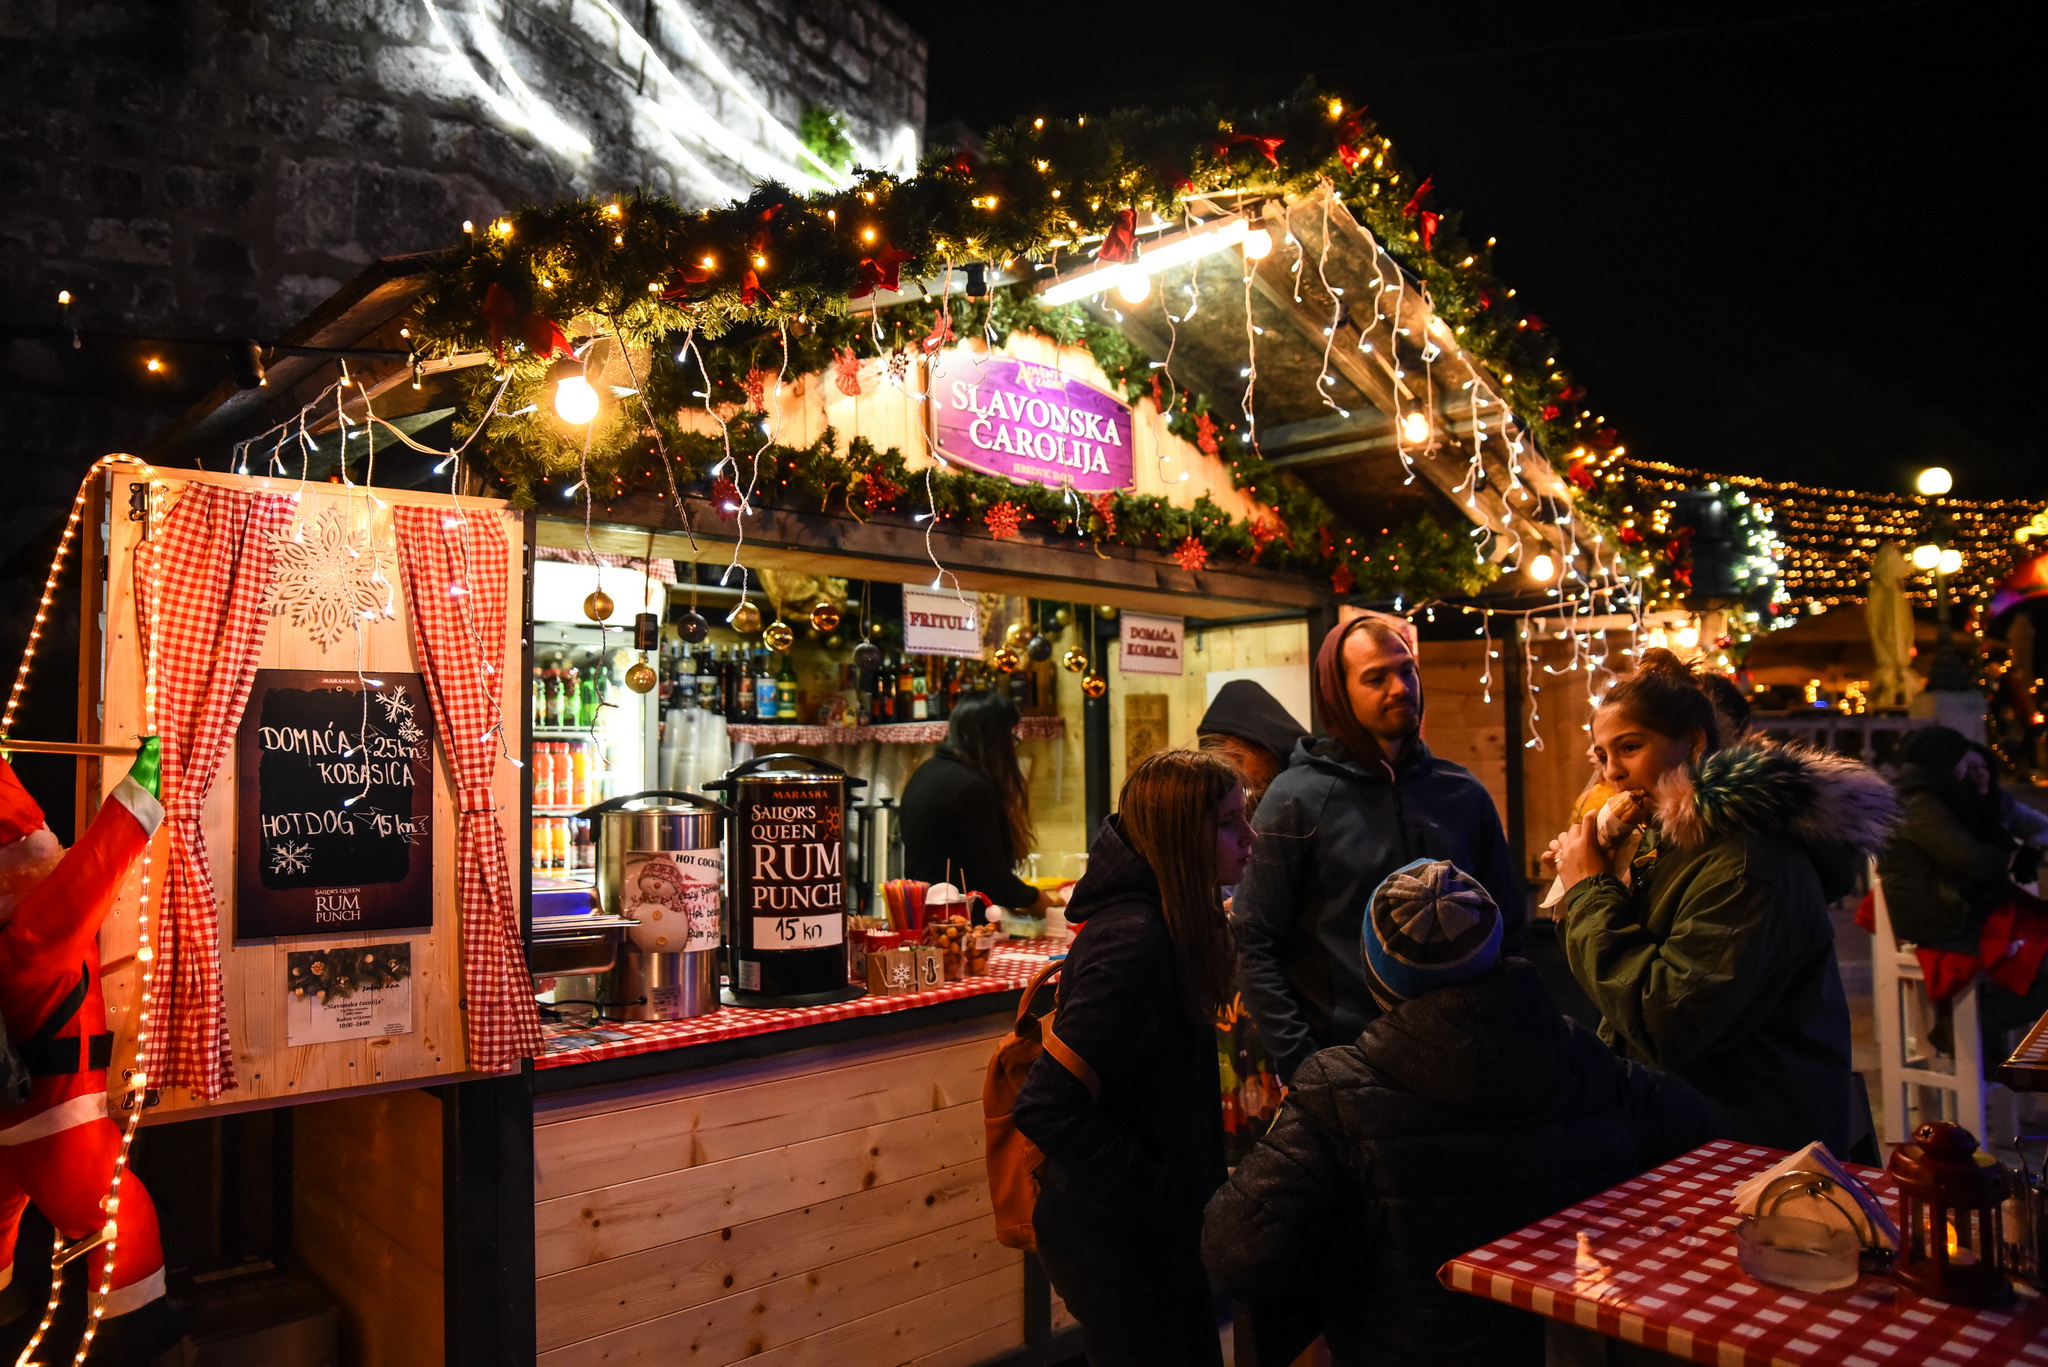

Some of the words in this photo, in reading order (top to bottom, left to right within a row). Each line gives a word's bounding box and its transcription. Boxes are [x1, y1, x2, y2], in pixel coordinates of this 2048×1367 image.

[951, 380, 1122, 447] SLAVONSKA
[969, 412, 1110, 475] ČAROLIJA
[259, 721, 351, 755] DOMAĆA
[317, 761, 415, 787] KOBASICA
[772, 790, 828, 799] MARASKA
[751, 804, 817, 823] SAILOR'S
[751, 823, 817, 843] QUEEN
[675, 853, 695, 865] HOT
[752, 842, 841, 880] RUM
[316, 895, 360, 911] RUM
[752, 883, 842, 910] PUNCH
[316, 910, 360, 922] PUNCH
[775, 918, 800, 941] 15
[803, 922, 822, 940] kn
